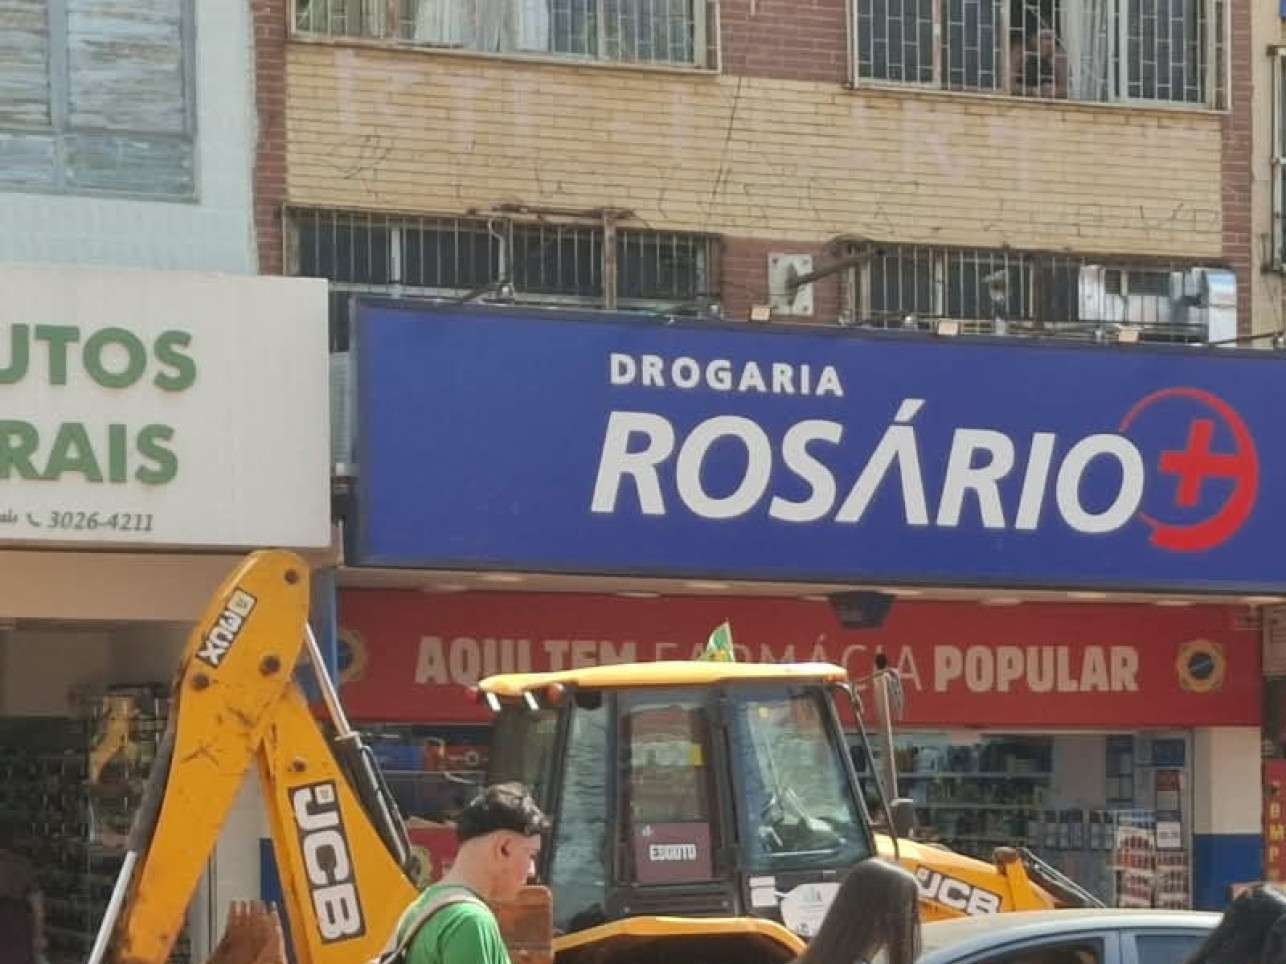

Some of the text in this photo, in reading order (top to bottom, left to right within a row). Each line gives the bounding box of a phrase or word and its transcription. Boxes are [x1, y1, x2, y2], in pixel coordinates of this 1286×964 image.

[609, 353, 845, 398] DROGARIA
[591, 397, 1146, 535] ROSÁRIO
[415, 636, 532, 690] AQUI
[933, 644, 1140, 693] POPULAR
[293, 783, 362, 940] JCB
[916, 867, 1001, 914] JCB
